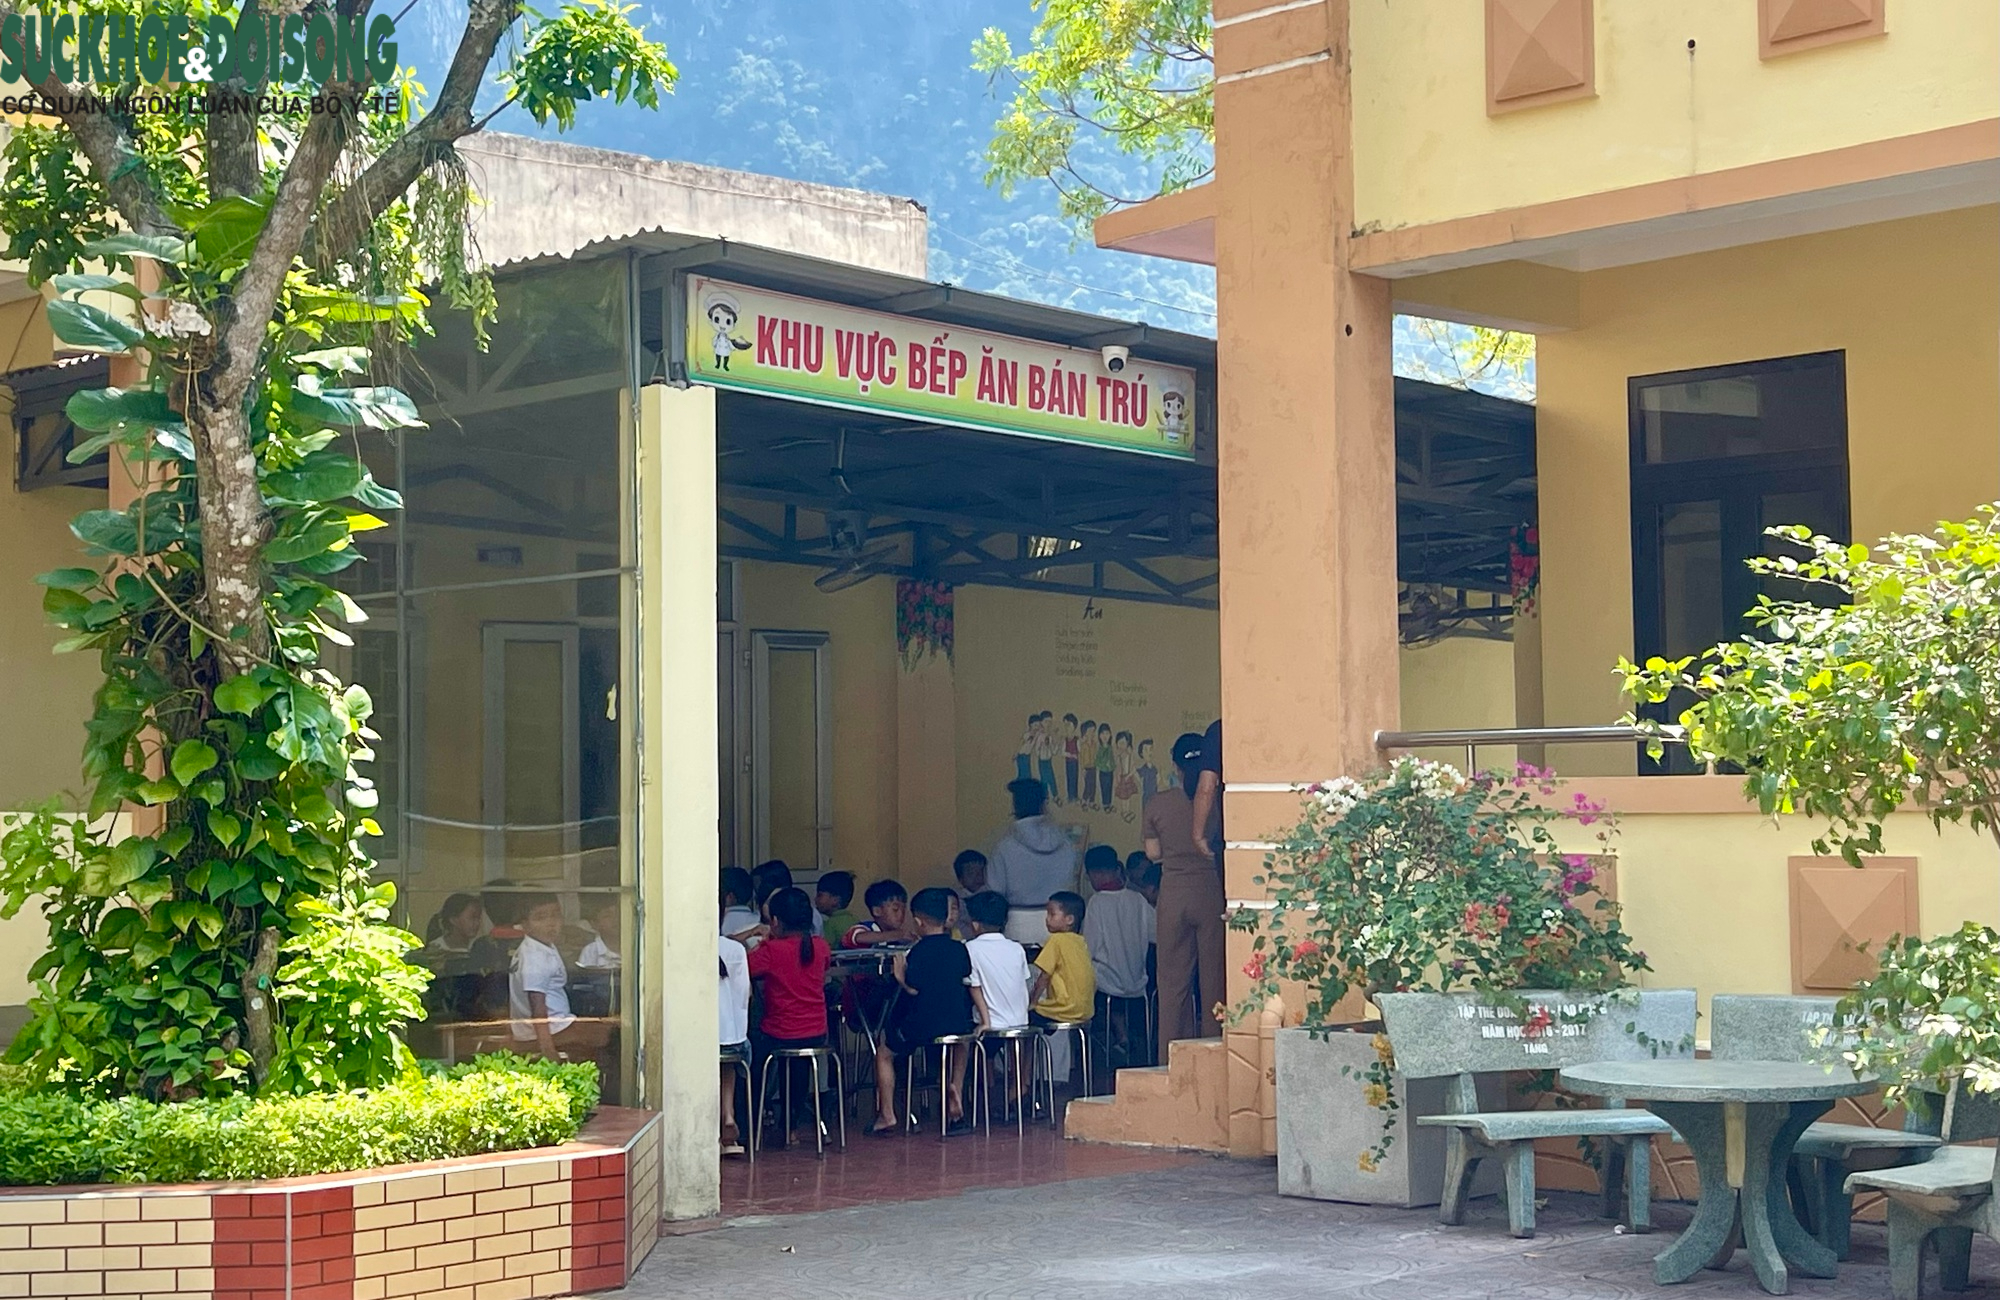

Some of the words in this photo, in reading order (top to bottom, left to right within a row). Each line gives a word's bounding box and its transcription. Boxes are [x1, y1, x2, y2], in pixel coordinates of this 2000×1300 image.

[757, 315, 824, 373] KHU
[835, 329, 897, 393] VỰC
[908, 332, 968, 396] BẾP
[977, 345, 1018, 406] ĂN
[1028, 359, 1087, 418] BÁN
[1096, 373, 1148, 428] TRÚ
[1561, 1023, 1587, 1037] 2017
